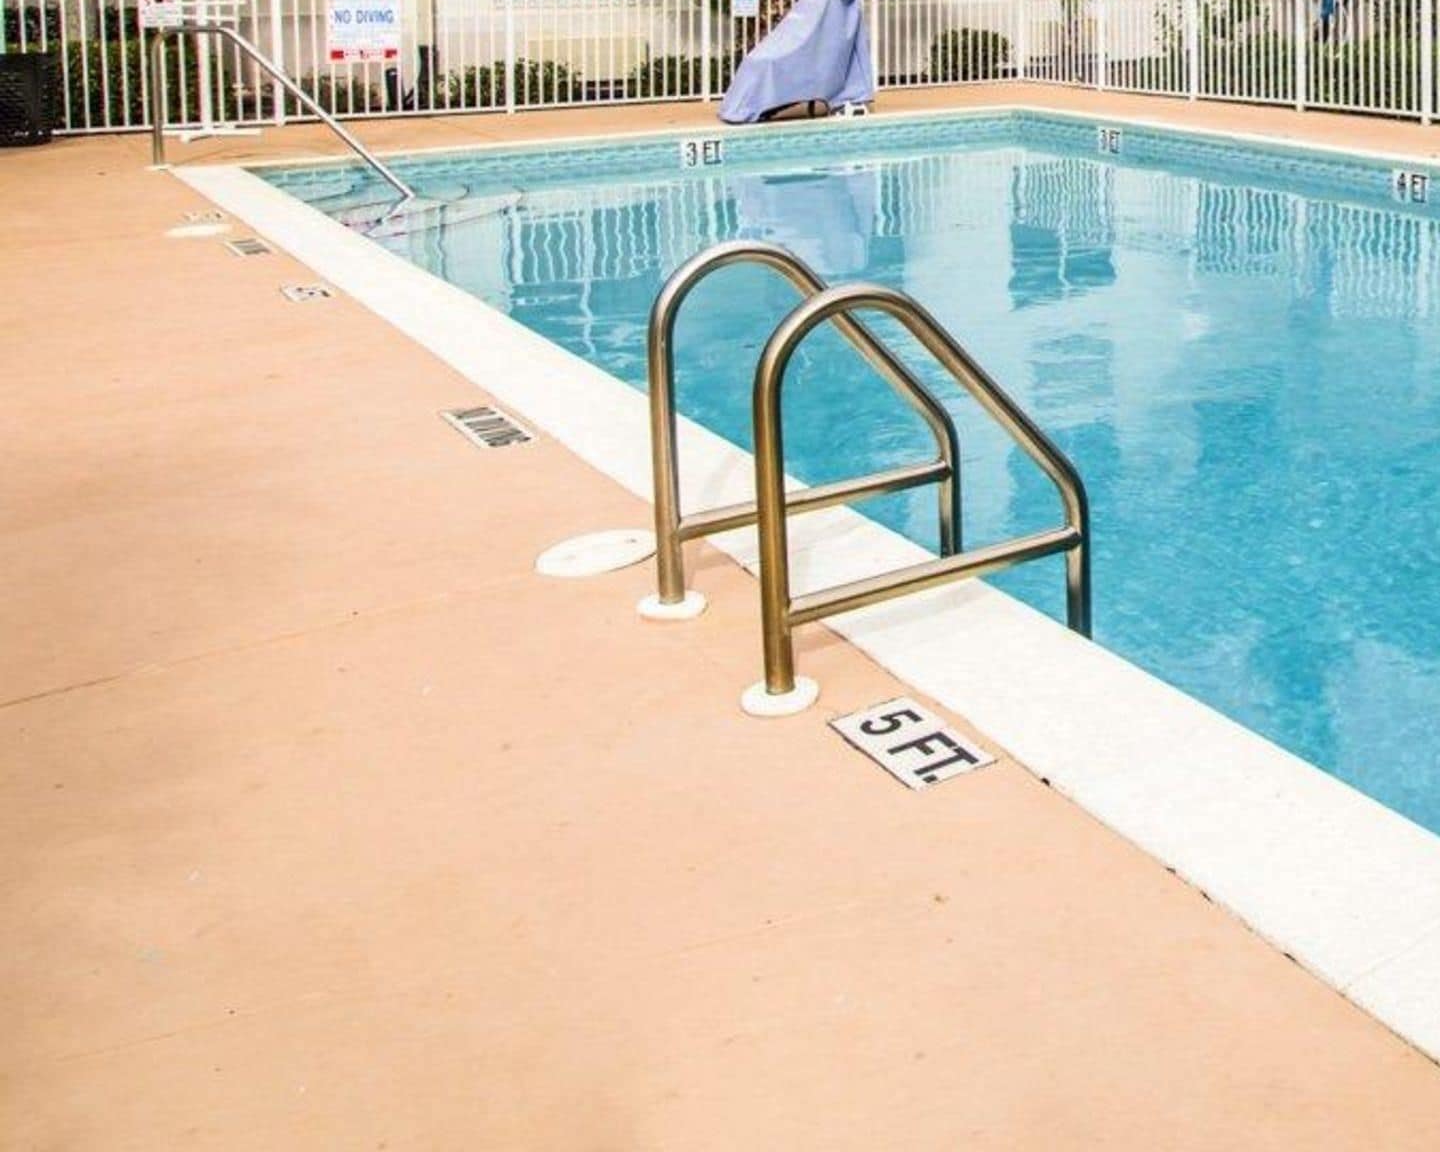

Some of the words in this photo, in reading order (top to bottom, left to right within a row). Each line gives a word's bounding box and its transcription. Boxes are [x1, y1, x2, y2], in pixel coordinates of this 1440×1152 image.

[334, 10, 352, 24] NO
[356, 10, 394, 24] DIVING
[860, 709, 923, 735] 5
[887, 731, 980, 784] FT.
